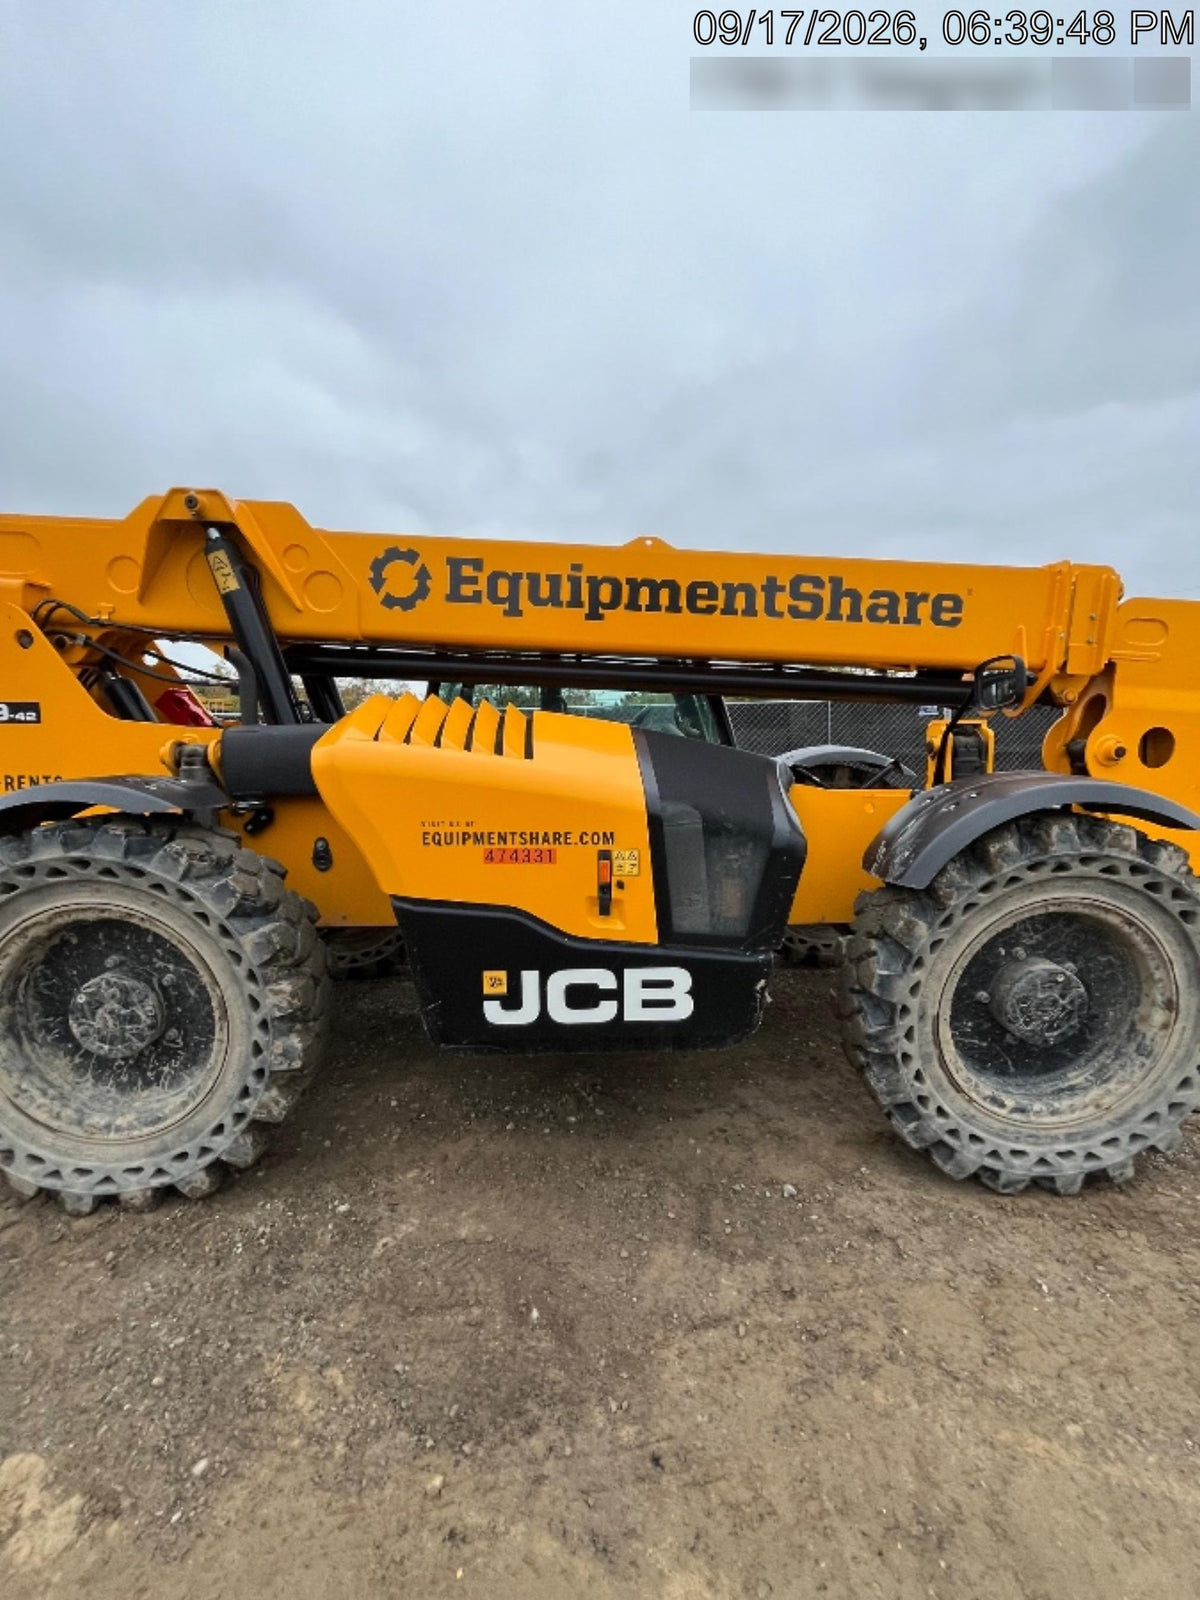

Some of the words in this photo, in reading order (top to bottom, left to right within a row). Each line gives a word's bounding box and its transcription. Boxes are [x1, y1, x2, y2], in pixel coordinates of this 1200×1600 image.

[445, 556, 964, 628] EquipmentShare
[422, 831, 615, 846] EQUIPMENTSHARE.COM
[484, 848, 555, 863] 474331
[482, 966, 695, 1025] JCB
